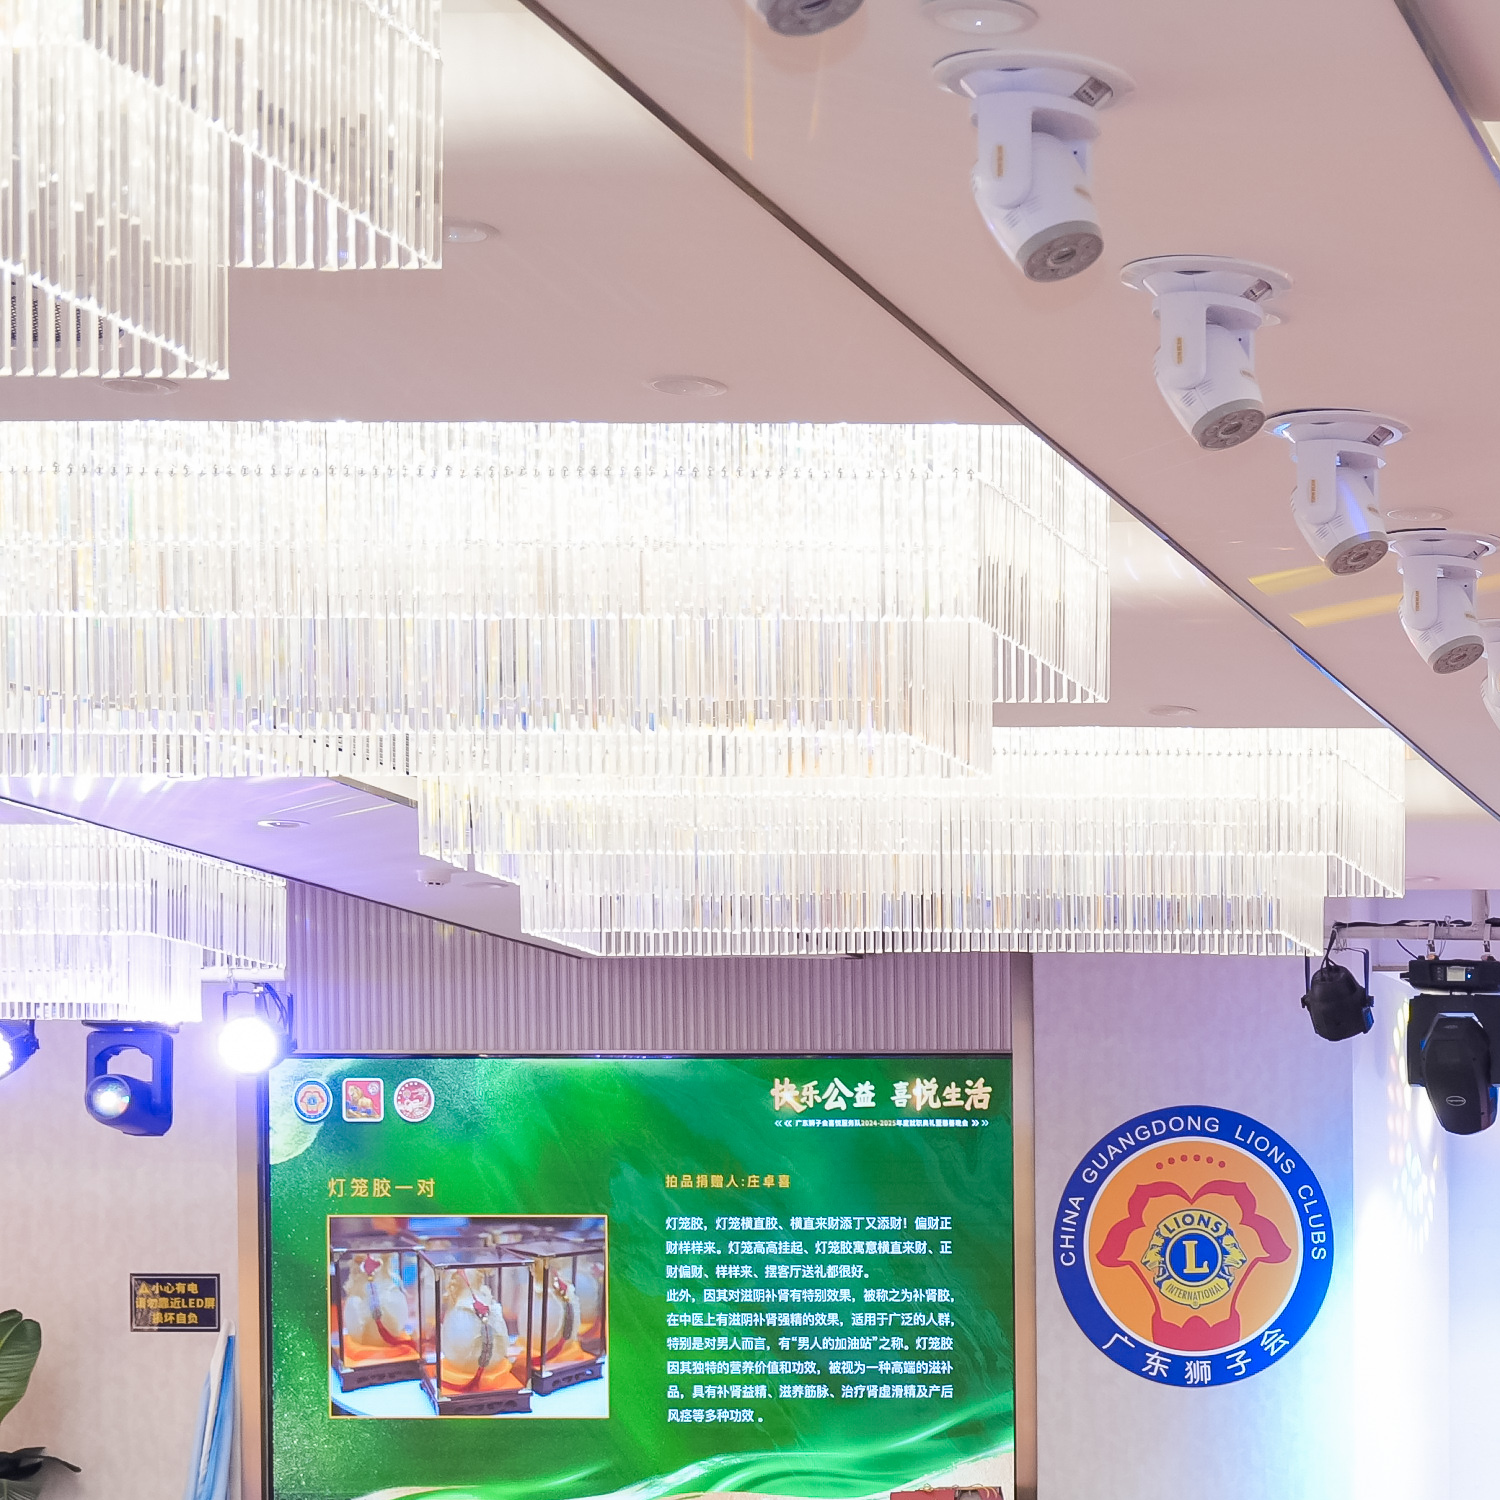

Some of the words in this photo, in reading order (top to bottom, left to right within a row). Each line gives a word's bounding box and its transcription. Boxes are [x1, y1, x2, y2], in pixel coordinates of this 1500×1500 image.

[770, 1077, 876, 1113] 快乐公益
[890, 1077, 993, 1112] 喜悦生活
[328, 1178, 436, 1198] 灯笼胶一对
[1060, 1194, 1085, 1267] CHINA
[1082, 1115, 1220, 1184] GUANGDONG
[1234, 1124, 1296, 1175] LIONS
[1297, 1184, 1327, 1261] CLUBS
[1163, 1213, 1224, 1234] LIONS
[1182, 1240, 1210, 1274] L
[151, 1282, 199, 1294] 小心有电
[1165, 1283, 1225, 1301] INTERNATIONAL
[1102, 1327, 1290, 1385] 广东狮子会
